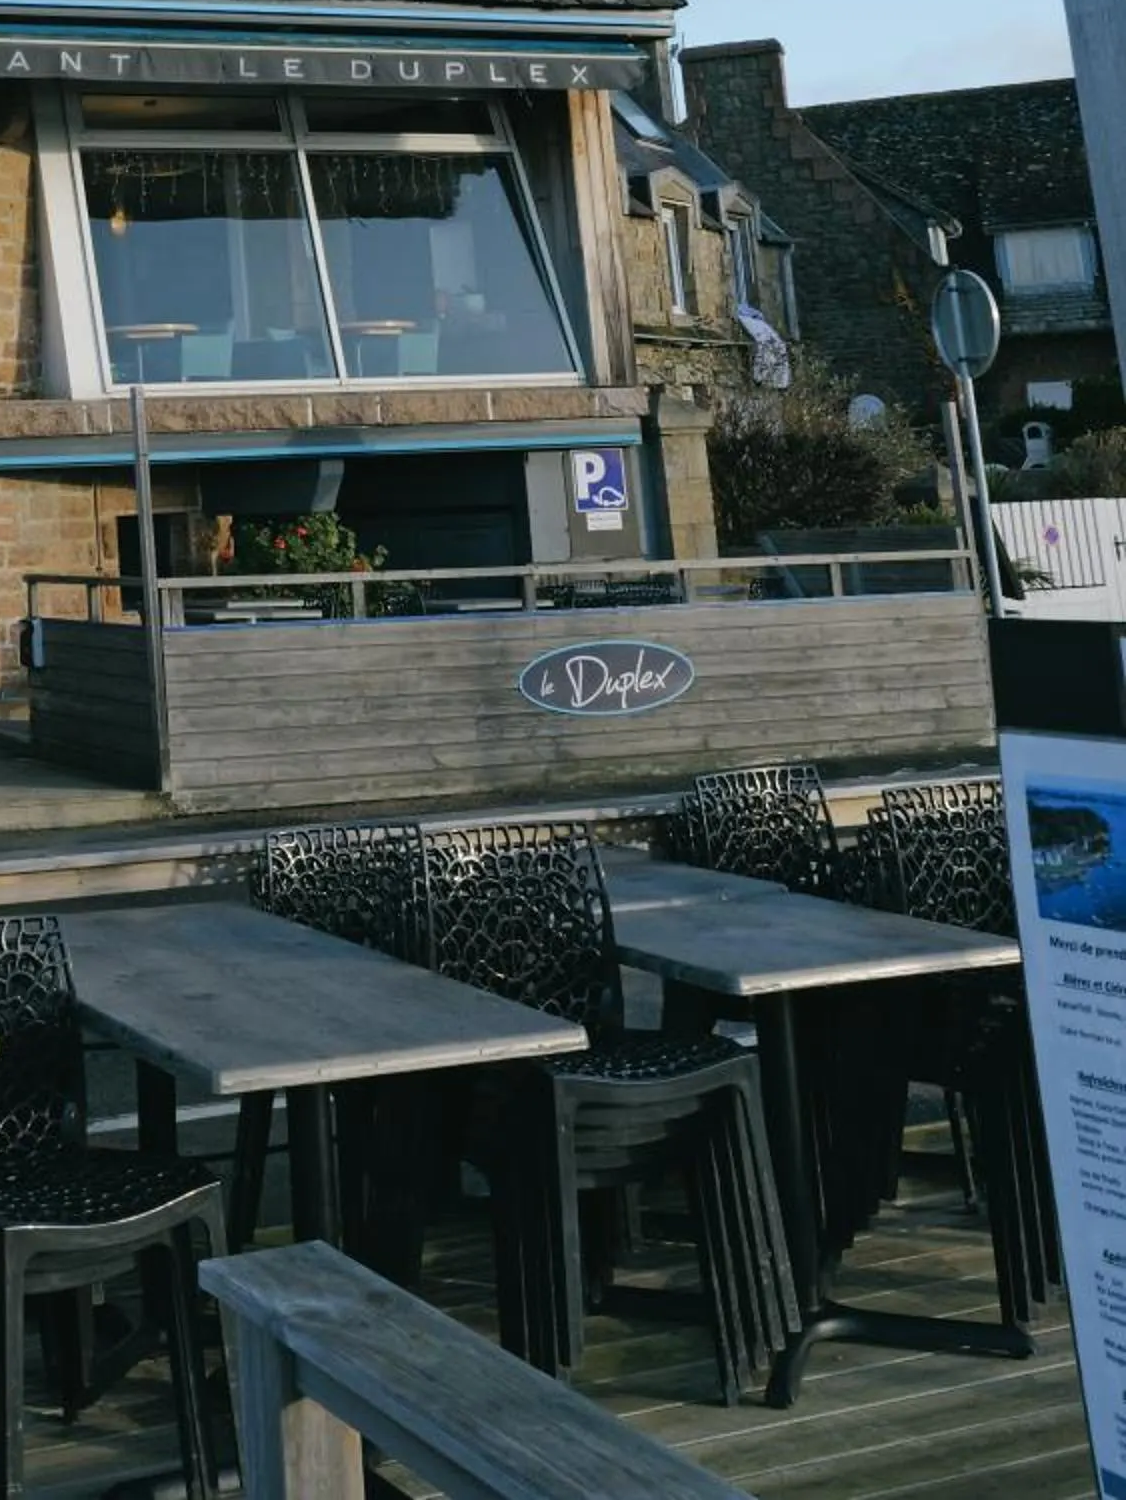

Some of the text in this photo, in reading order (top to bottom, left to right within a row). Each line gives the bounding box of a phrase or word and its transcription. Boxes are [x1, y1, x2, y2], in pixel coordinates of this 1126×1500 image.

[239, 57, 304, 78] LE
[351, 59, 590, 84] DUPLEX
[575, 452, 606, 500] P
[539, 647, 675, 708] le Duplex
